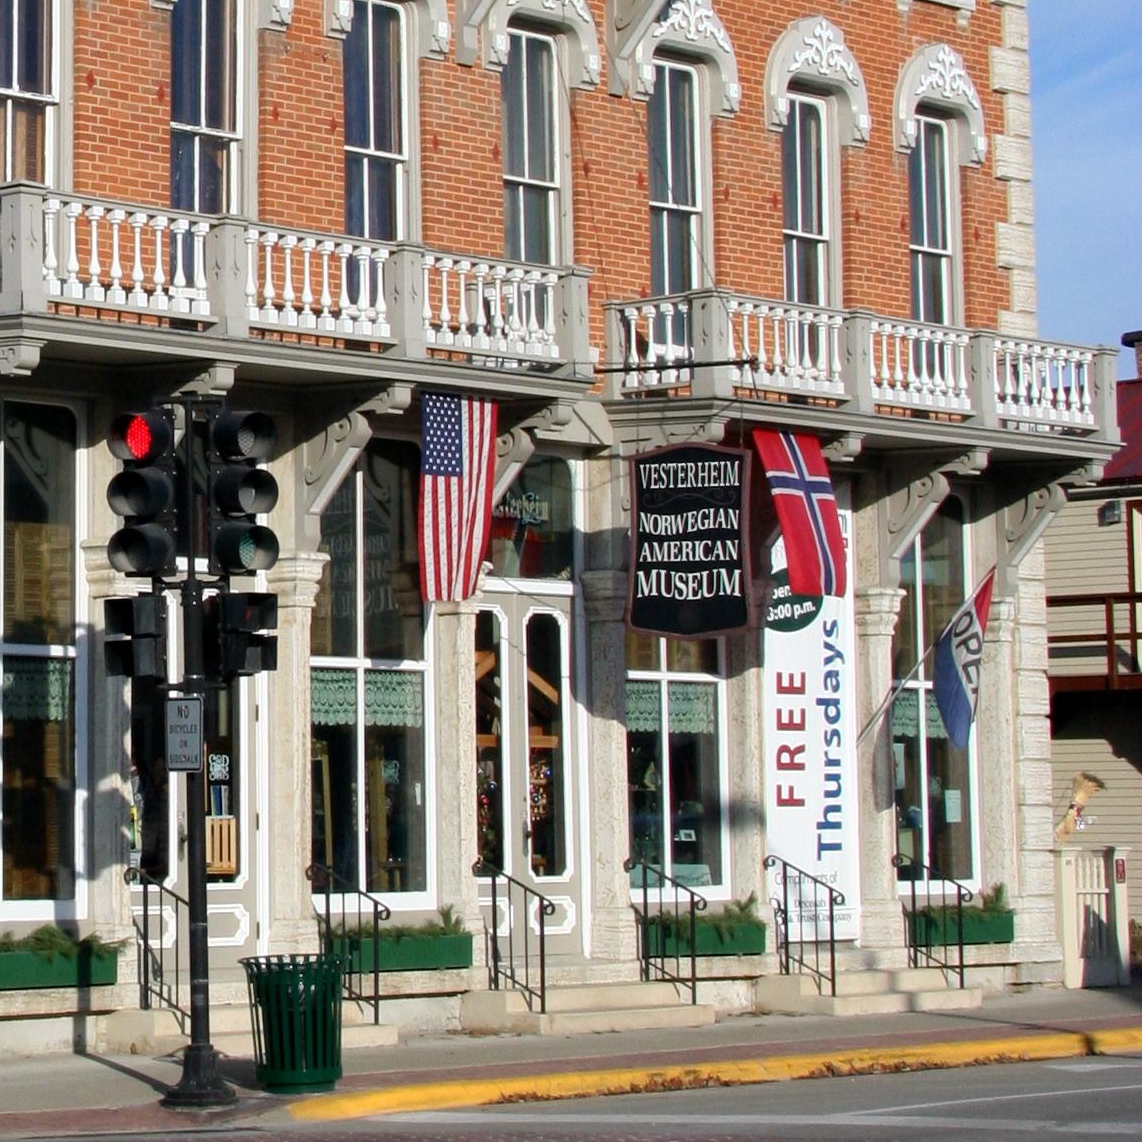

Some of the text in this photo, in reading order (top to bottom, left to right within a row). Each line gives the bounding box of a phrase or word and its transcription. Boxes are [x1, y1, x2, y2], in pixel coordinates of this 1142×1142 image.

[639, 461, 740, 489] VESTERHEIM
[639, 508, 739, 535] NORWEGIAN
[639, 540, 739, 562] AMERICAN
[636, 568, 742, 600] MUSEUM
[793, 601, 816, 619] p.m.
[177, 705, 189, 719] NO
[169, 724, 198, 734] BICYCLES
[776, 671, 806, 807] FREE
[816, 619, 845, 861] Thursdays
[817, 912, 852, 923] Copany
